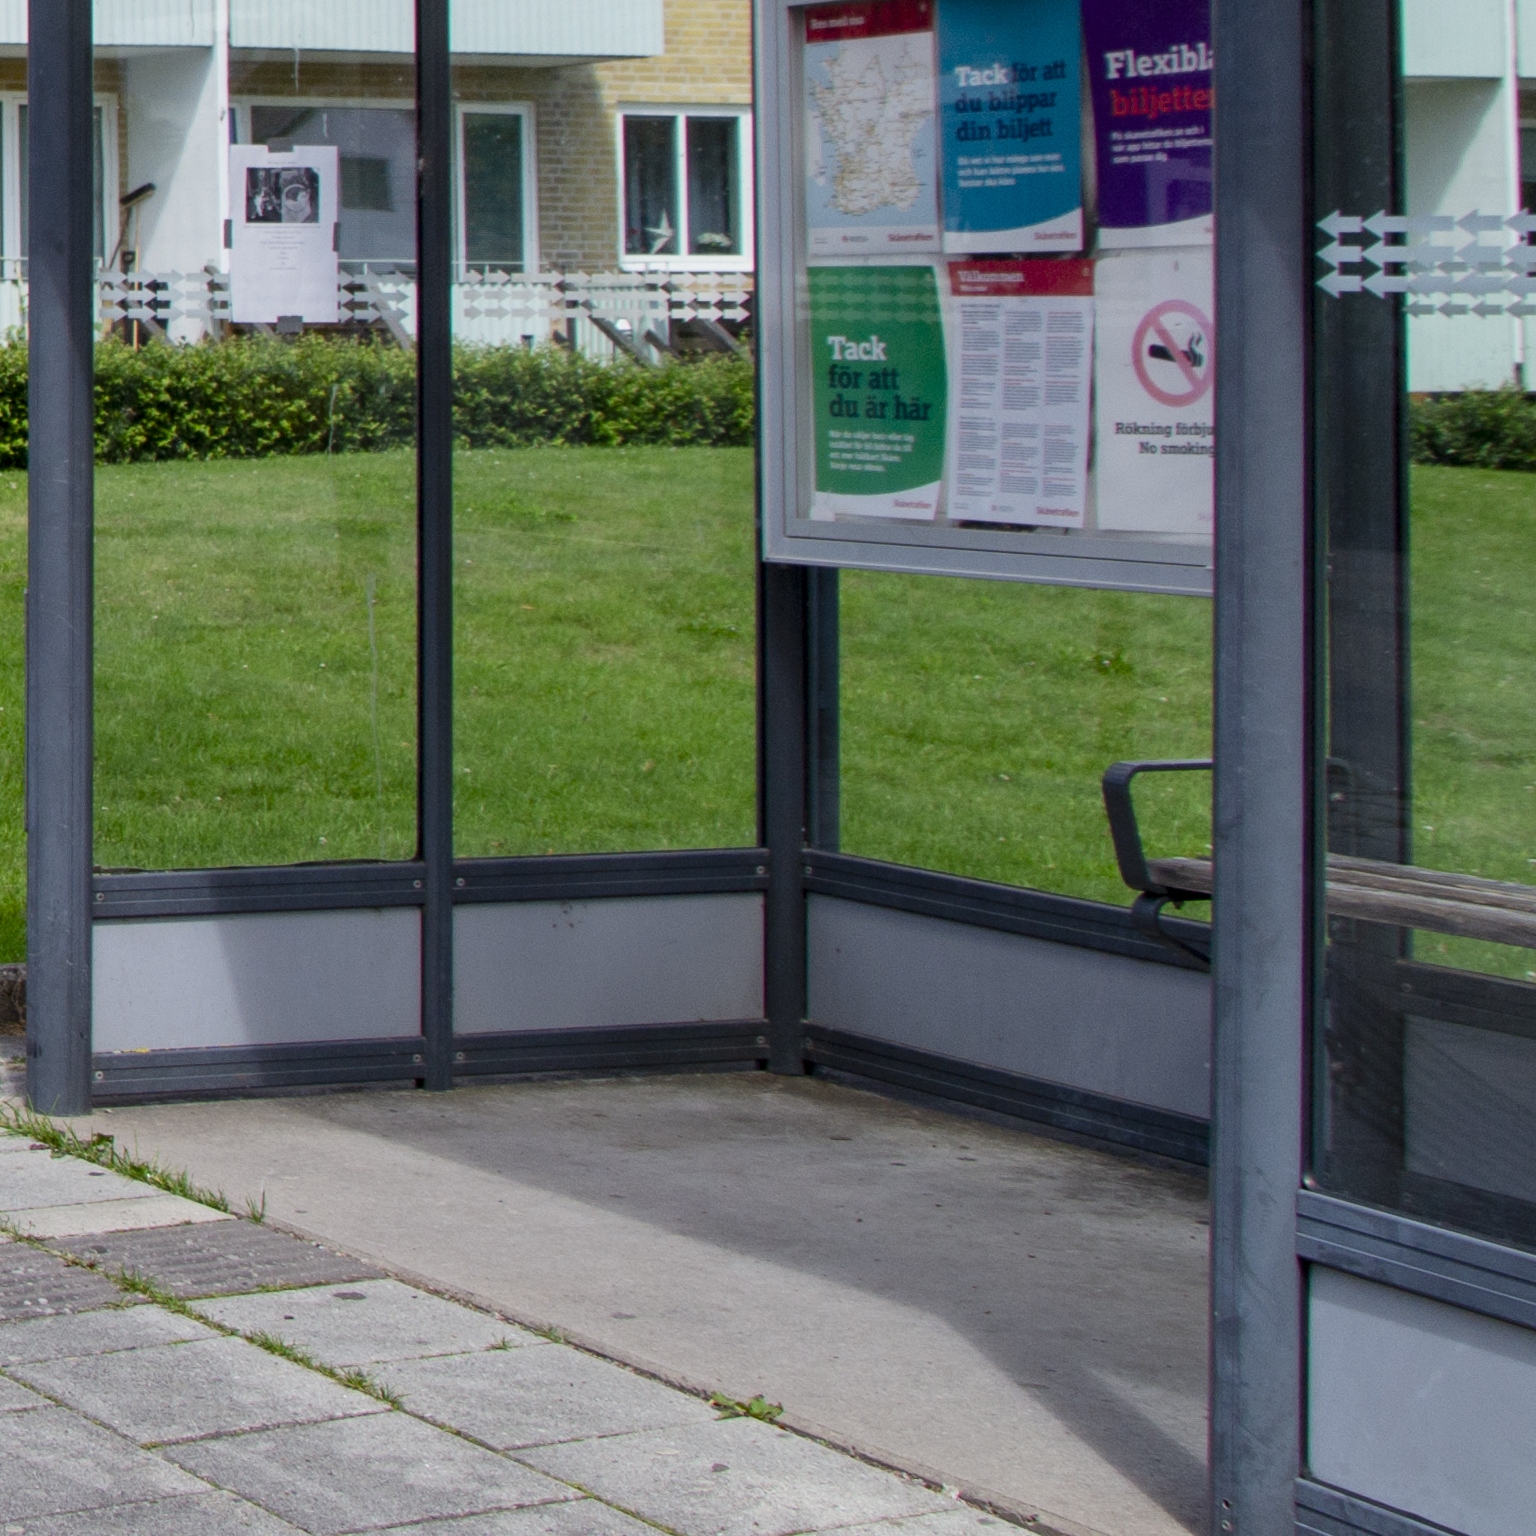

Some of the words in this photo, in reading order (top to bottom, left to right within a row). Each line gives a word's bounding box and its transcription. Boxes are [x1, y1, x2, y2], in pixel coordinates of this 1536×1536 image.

[955, 62, 1008, 87] Tack
[1011, 62, 1037, 82] för
[1043, 60, 1067, 80] att
[955, 92, 982, 113] du
[988, 90, 1058, 114] blippar
[956, 120, 991, 142] din
[996, 117, 1054, 143] biljett
[827, 335, 888, 361] Tack
[828, 364, 863, 390] för
[868, 367, 900, 391] att
[829, 394, 860, 418] du
[865, 395, 889, 419] är
[894, 395, 932, 421] här
[1115, 422, 1172, 438] Rökning
[1175, 422, 1215, 438] förbju
[1138, 442, 1158, 455] No
